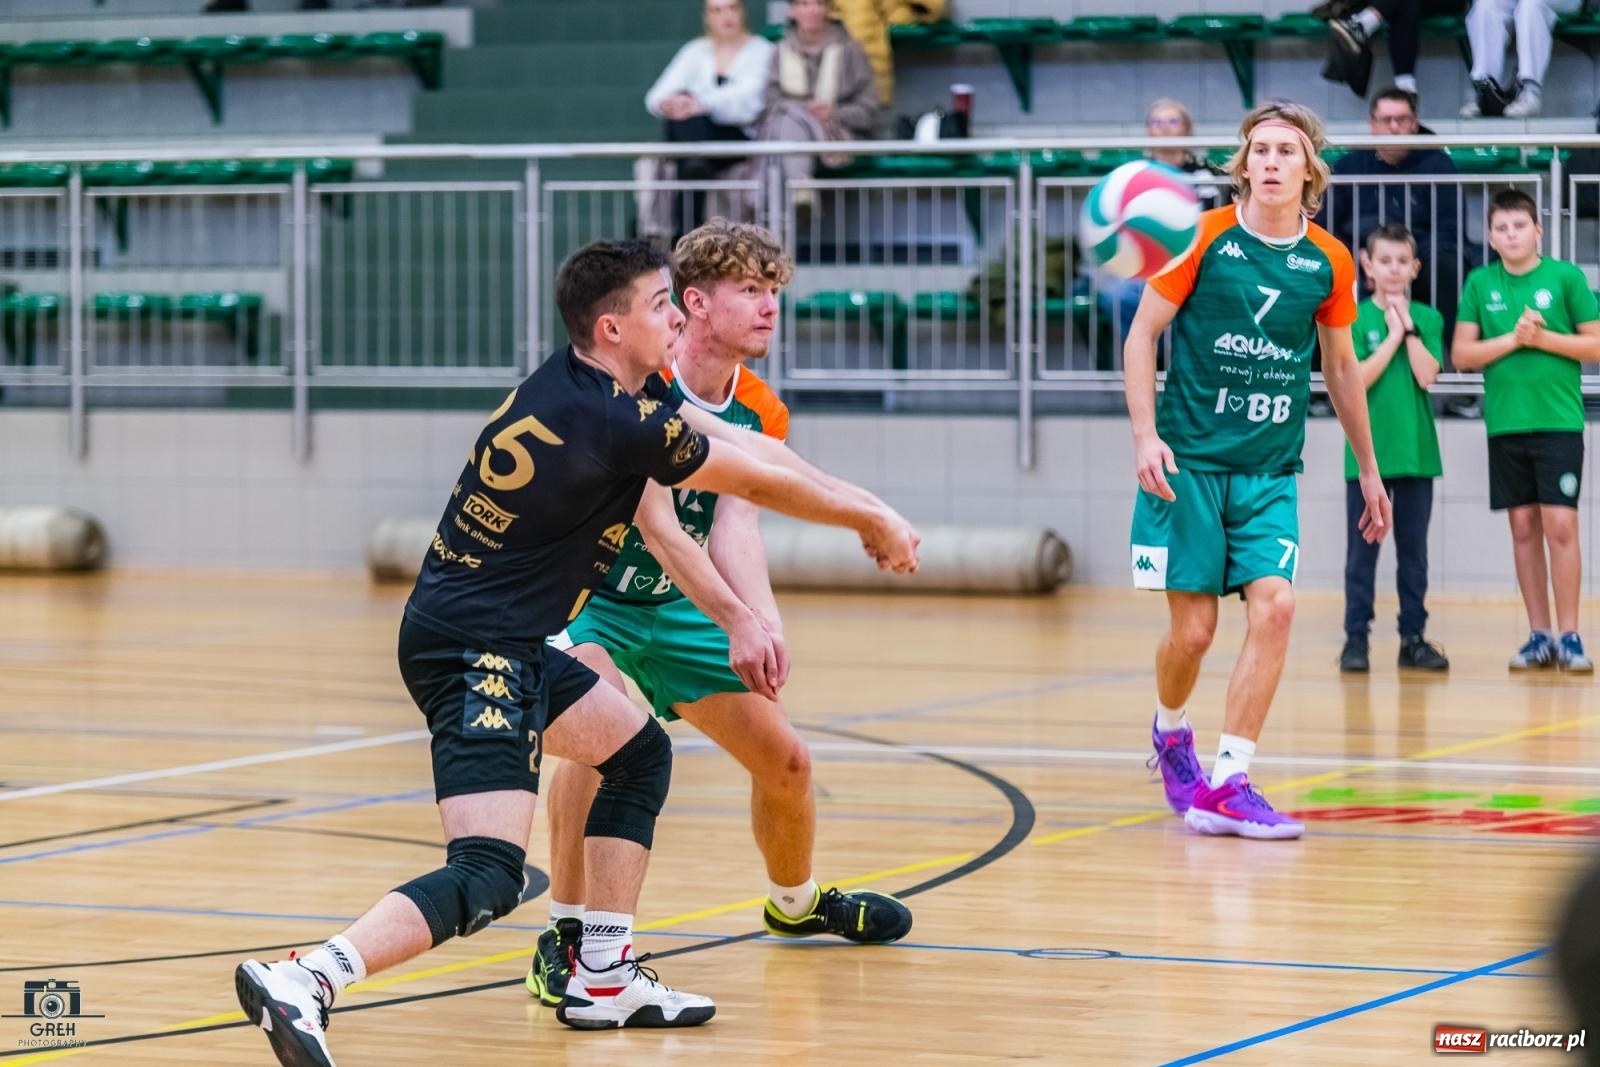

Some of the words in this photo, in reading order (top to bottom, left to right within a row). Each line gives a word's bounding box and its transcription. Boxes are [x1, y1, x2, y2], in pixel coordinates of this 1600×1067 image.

[1255, 285, 1281, 325] 7
[1247, 393, 1292, 424] BB
[465, 498, 509, 530] TORK
[1276, 537, 1294, 569] 7
